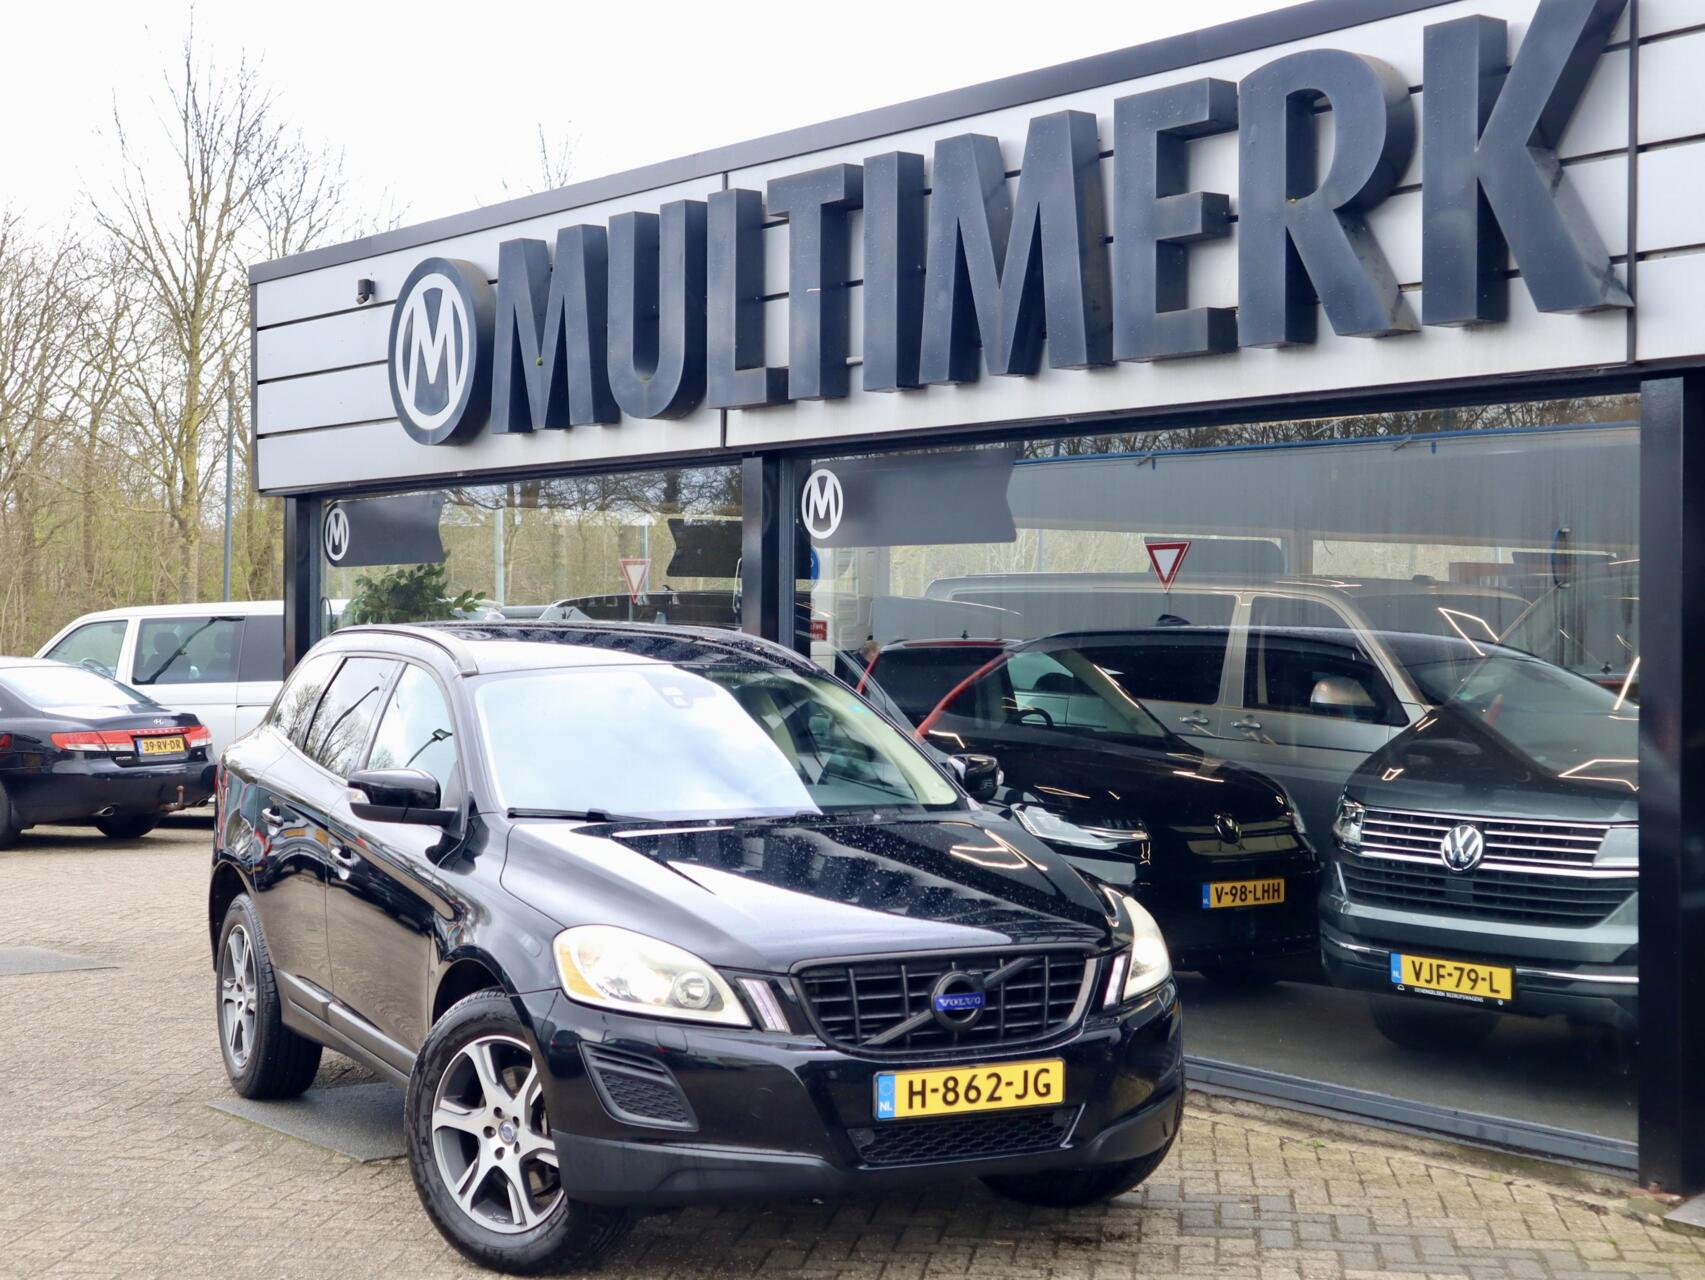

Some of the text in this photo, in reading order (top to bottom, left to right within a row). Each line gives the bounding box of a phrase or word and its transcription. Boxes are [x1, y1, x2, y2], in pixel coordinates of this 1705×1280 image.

[490, 0, 1636, 435] MULTIMERK
[143, 739, 182, 752] 39-RV-DR
[1214, 882, 1281, 904] V-98-LHH
[1411, 959, 1501, 994] VJF-79-L
[938, 996, 982, 1007] VOLVO
[879, 1067, 1052, 1112] NL H-862-JG
